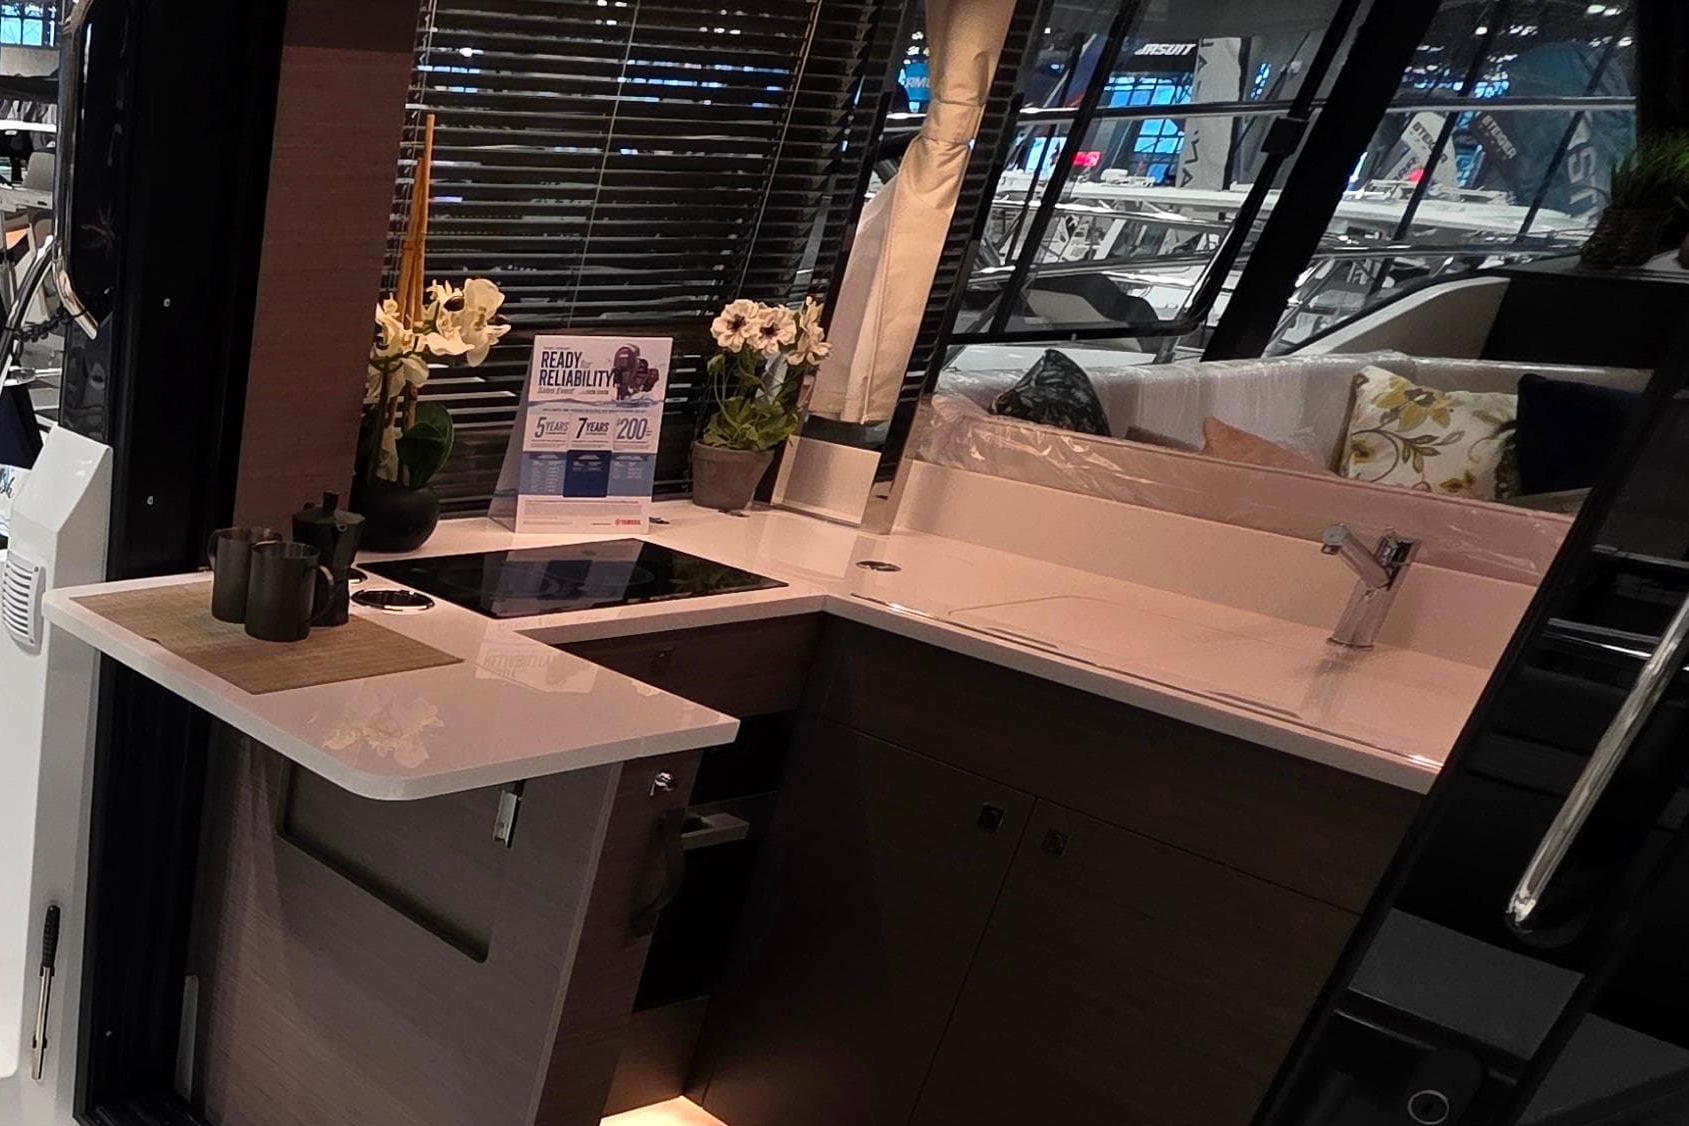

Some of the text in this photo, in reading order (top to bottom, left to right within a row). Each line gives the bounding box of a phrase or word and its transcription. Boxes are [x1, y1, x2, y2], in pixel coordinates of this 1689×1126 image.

[540, 350, 583, 369] READY
[538, 369, 616, 388] RELIABILITY
[534, 416, 569, 439] 5 YEARS
[575, 417, 610, 440] 7 YEARS
